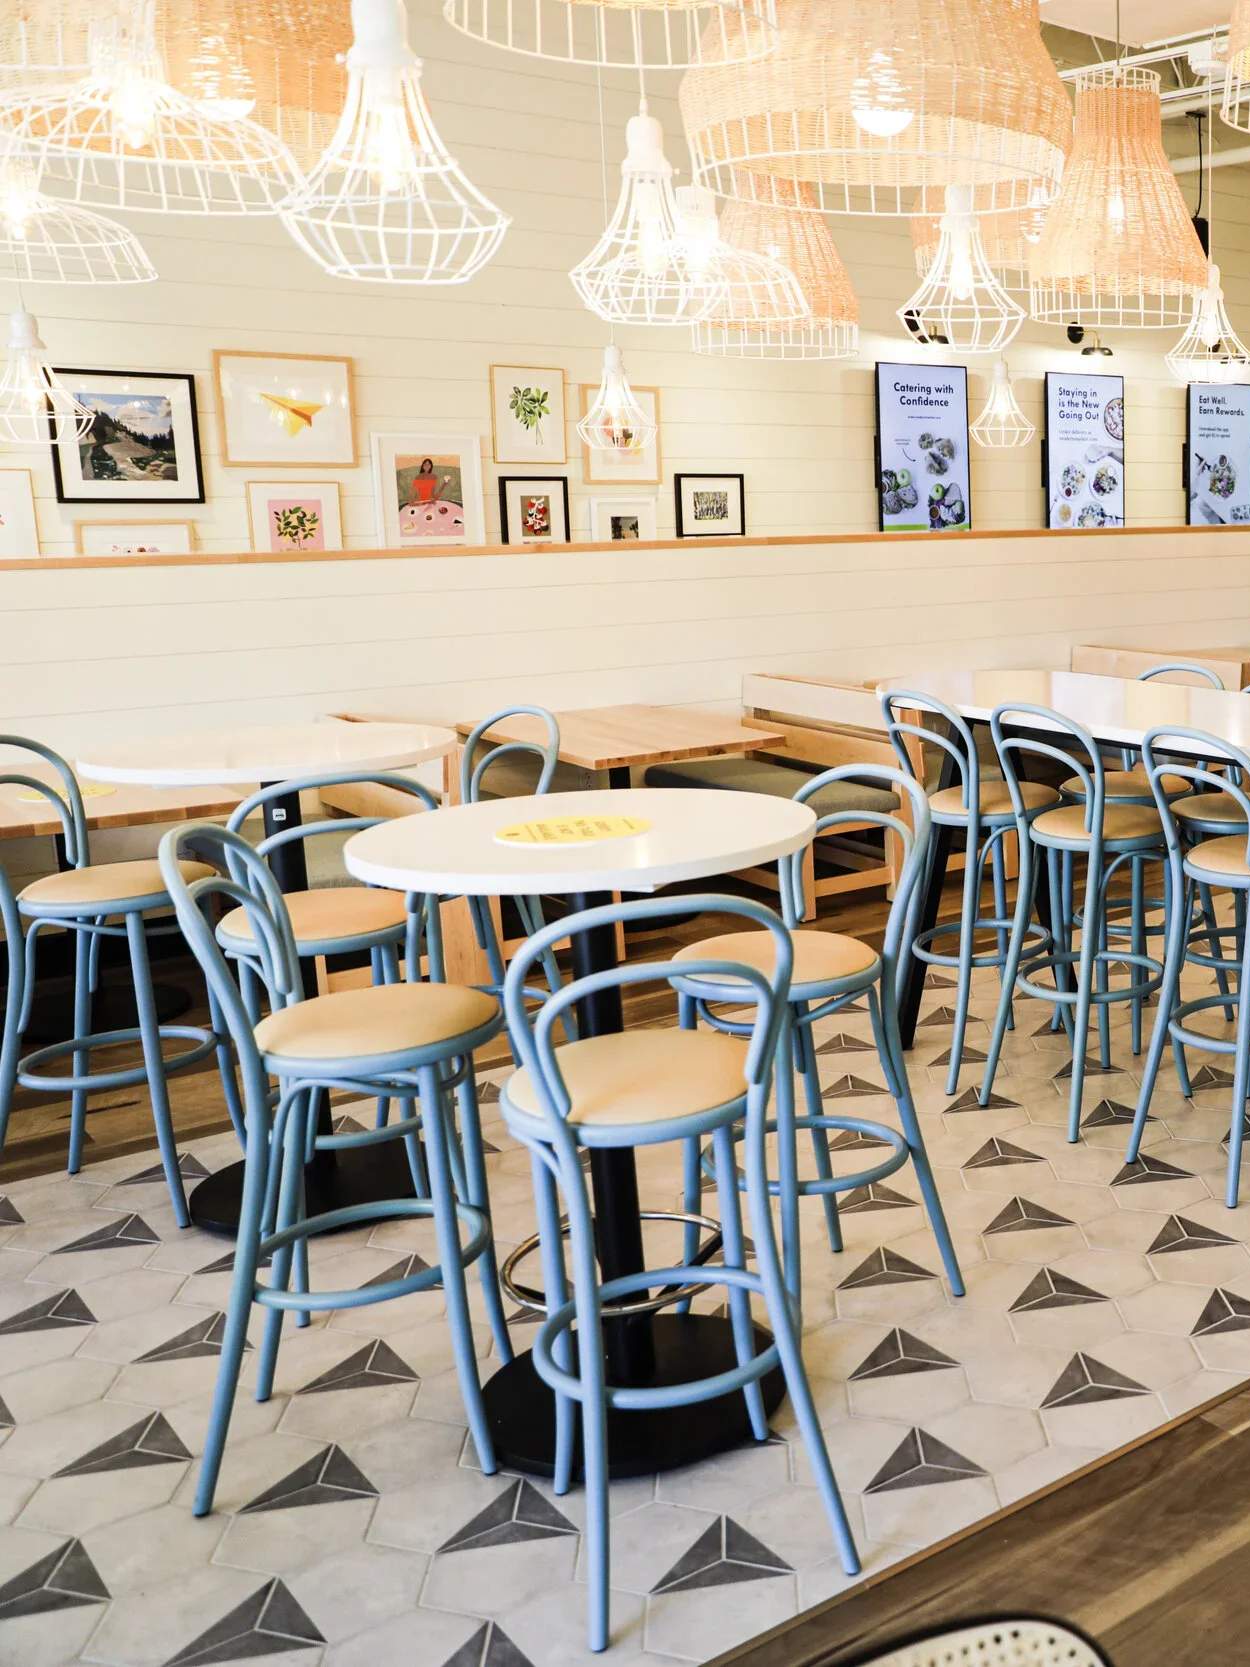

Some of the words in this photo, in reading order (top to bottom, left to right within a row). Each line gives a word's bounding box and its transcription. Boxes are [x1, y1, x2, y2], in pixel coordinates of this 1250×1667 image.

[894, 382, 932, 395] Catering
[934, 384, 954, 394] with
[1058, 386, 1088, 399] Staying
[1090, 388, 1097, 397] in
[900, 395, 949, 407] Confidence
[1058, 398, 1066, 408] is
[1067, 399, 1080, 408] the
[1082, 399, 1100, 409] New
[1198, 395, 1210, 404] Eat
[1058, 409, 1083, 422] Going
[1085, 410, 1099, 420] Out
[1198, 405, 1214, 415] Earn
[1215, 406, 1245, 416] Rewards.
